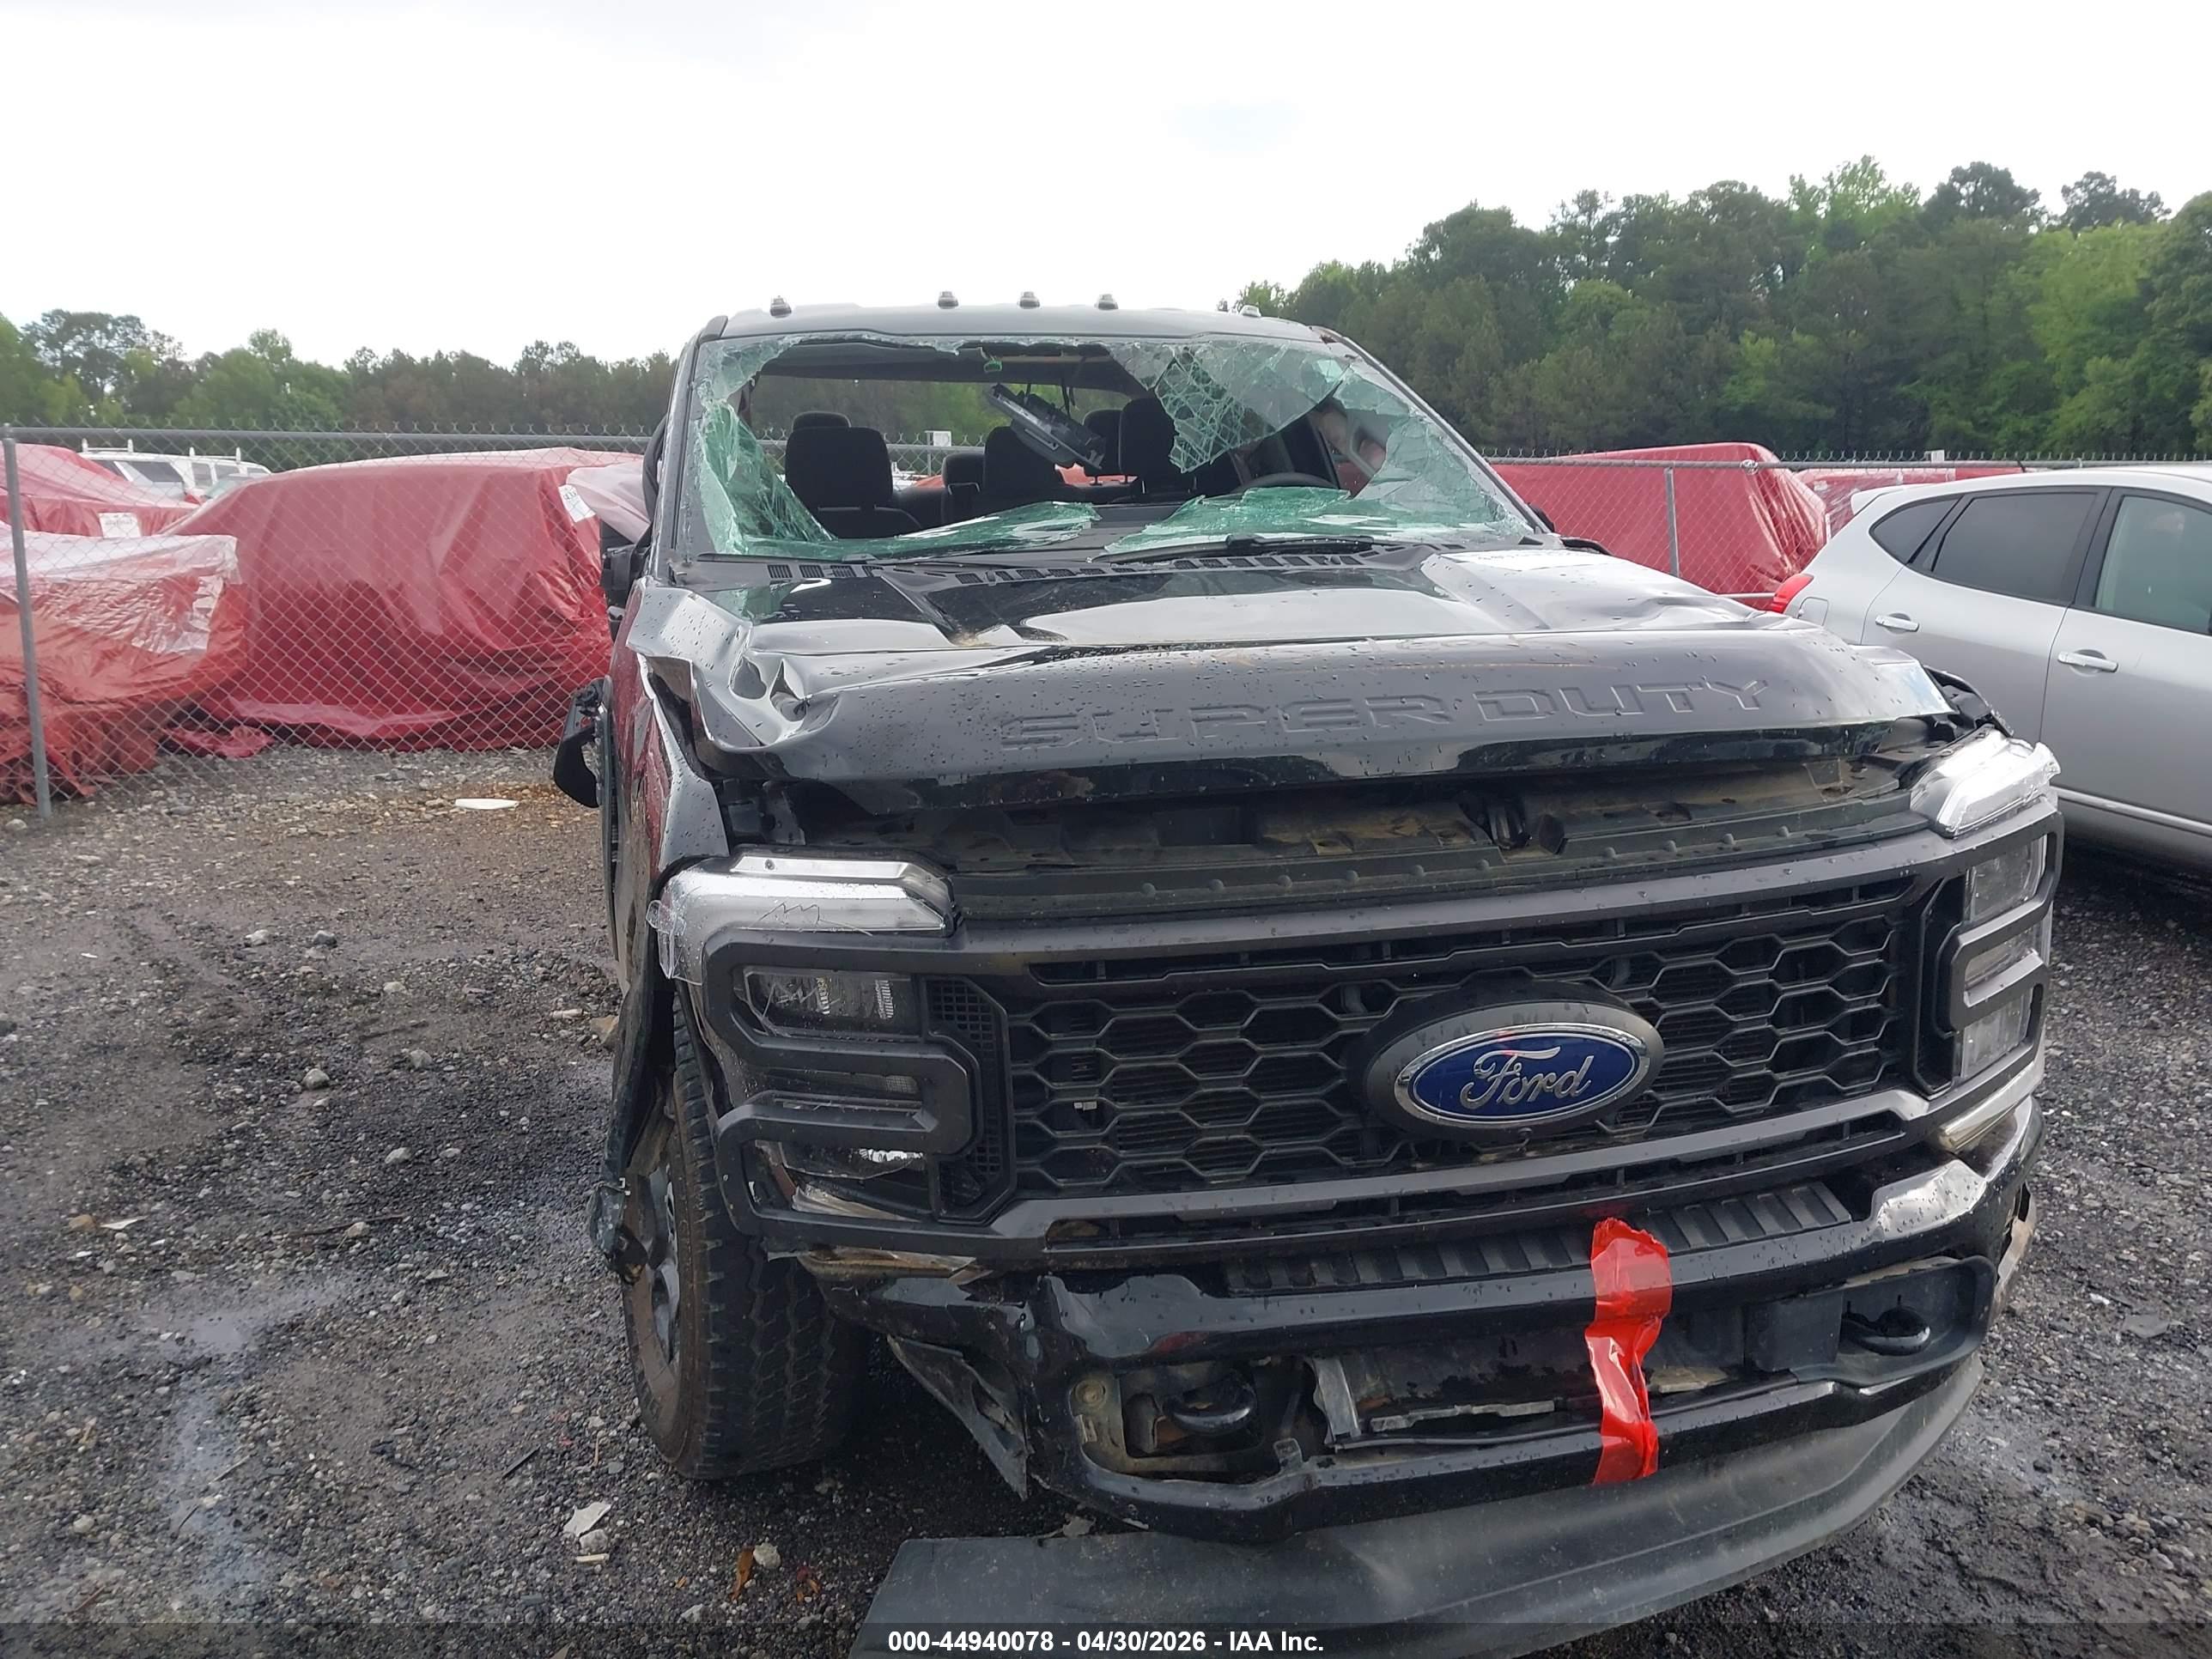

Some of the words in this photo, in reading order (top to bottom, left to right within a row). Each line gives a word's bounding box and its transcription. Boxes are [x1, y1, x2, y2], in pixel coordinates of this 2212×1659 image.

[999, 694, 1455, 751] SUPER
[1472, 675, 1769, 722] DUTY
[1460, 1046, 1594, 1109] Ford
